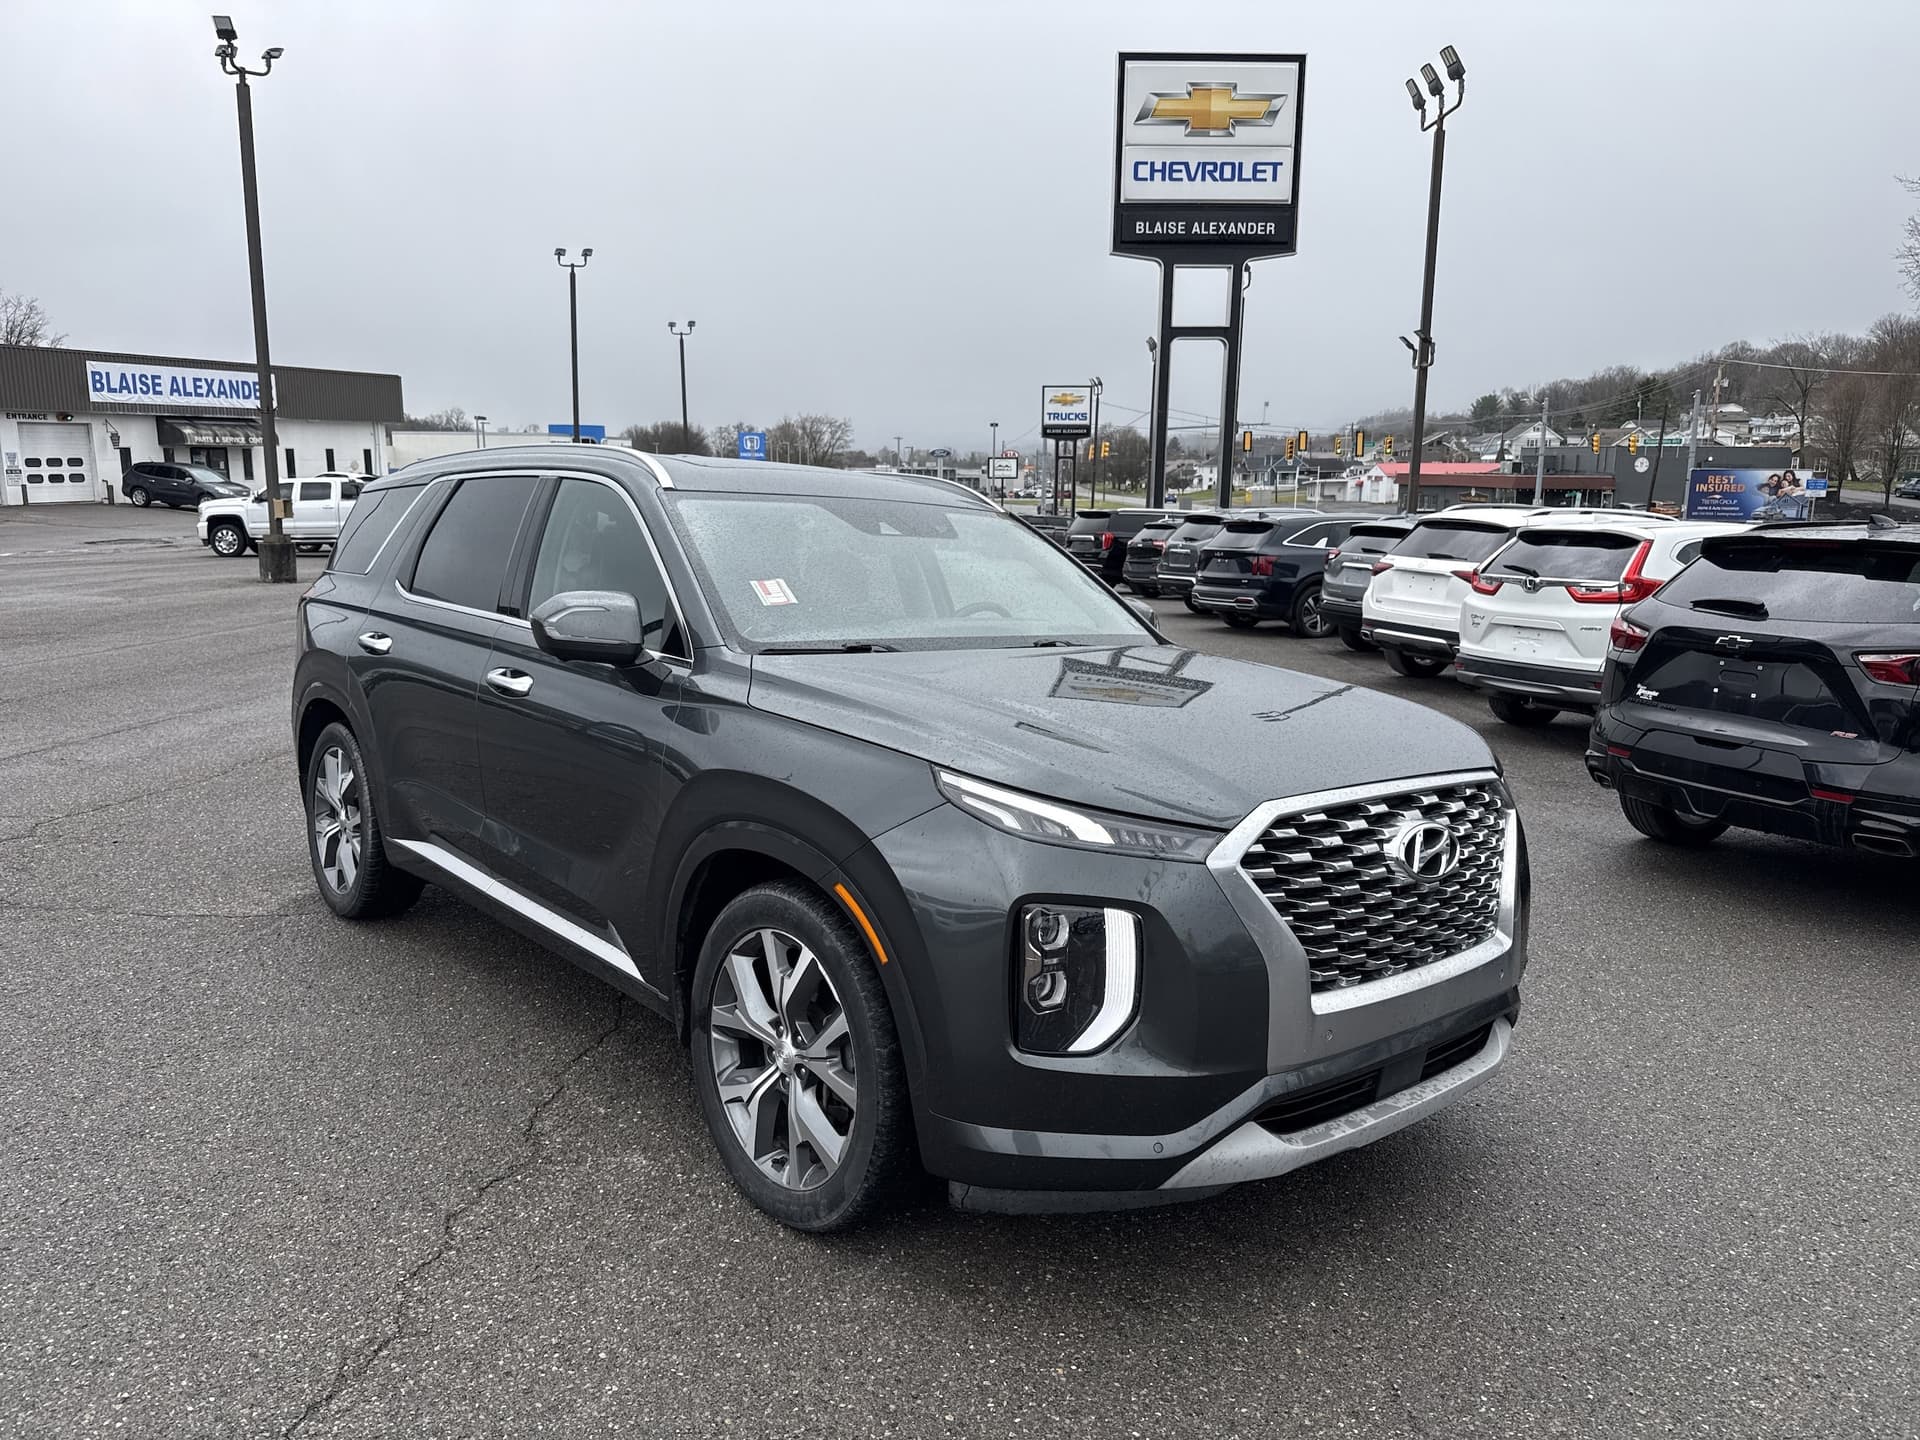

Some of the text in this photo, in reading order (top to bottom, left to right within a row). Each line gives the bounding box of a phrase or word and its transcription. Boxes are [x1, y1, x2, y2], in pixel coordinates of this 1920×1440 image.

[1133, 161, 1283, 182] CHEVROLET
[1135, 221, 1275, 235] BLAISE ALEXANDER
[91, 370, 260, 400] BLAISE ALEXANDE
[6, 412, 48, 421] ENTRANCE
[1047, 412, 1088, 421] TRUCKS
[1708, 475, 1736, 484] REST
[1695, 483, 1745, 493] INSURED
